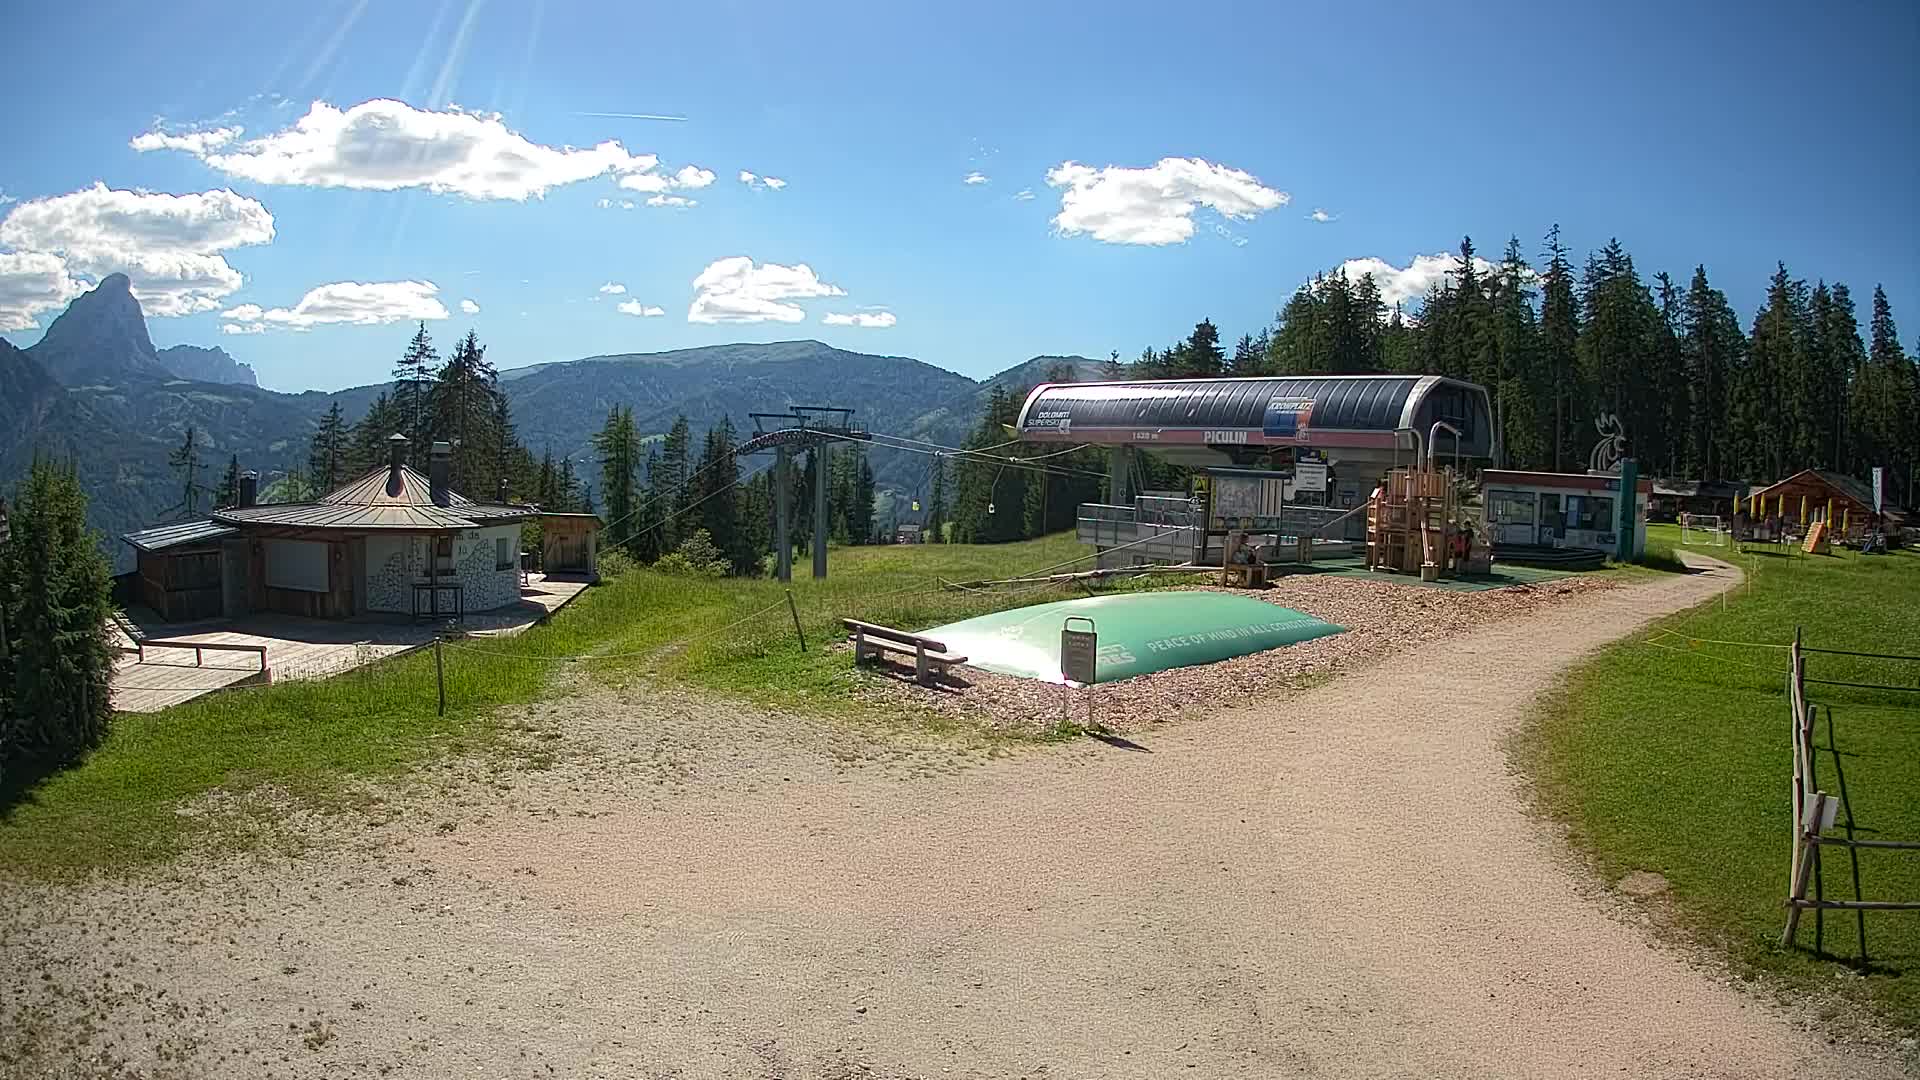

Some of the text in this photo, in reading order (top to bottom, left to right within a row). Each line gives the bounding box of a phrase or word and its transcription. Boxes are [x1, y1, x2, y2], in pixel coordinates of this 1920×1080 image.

[1038, 411, 1070, 419] DOLOMITI
[1203, 431, 1247, 444] PICULIN
[1146, 636, 1190, 653] PEACE
[1189, 633, 1206, 645] OF
[1207, 629, 1239, 641] MIND
[1237, 626, 1250, 639] IN
[1249, 624, 1272, 635] ALL
